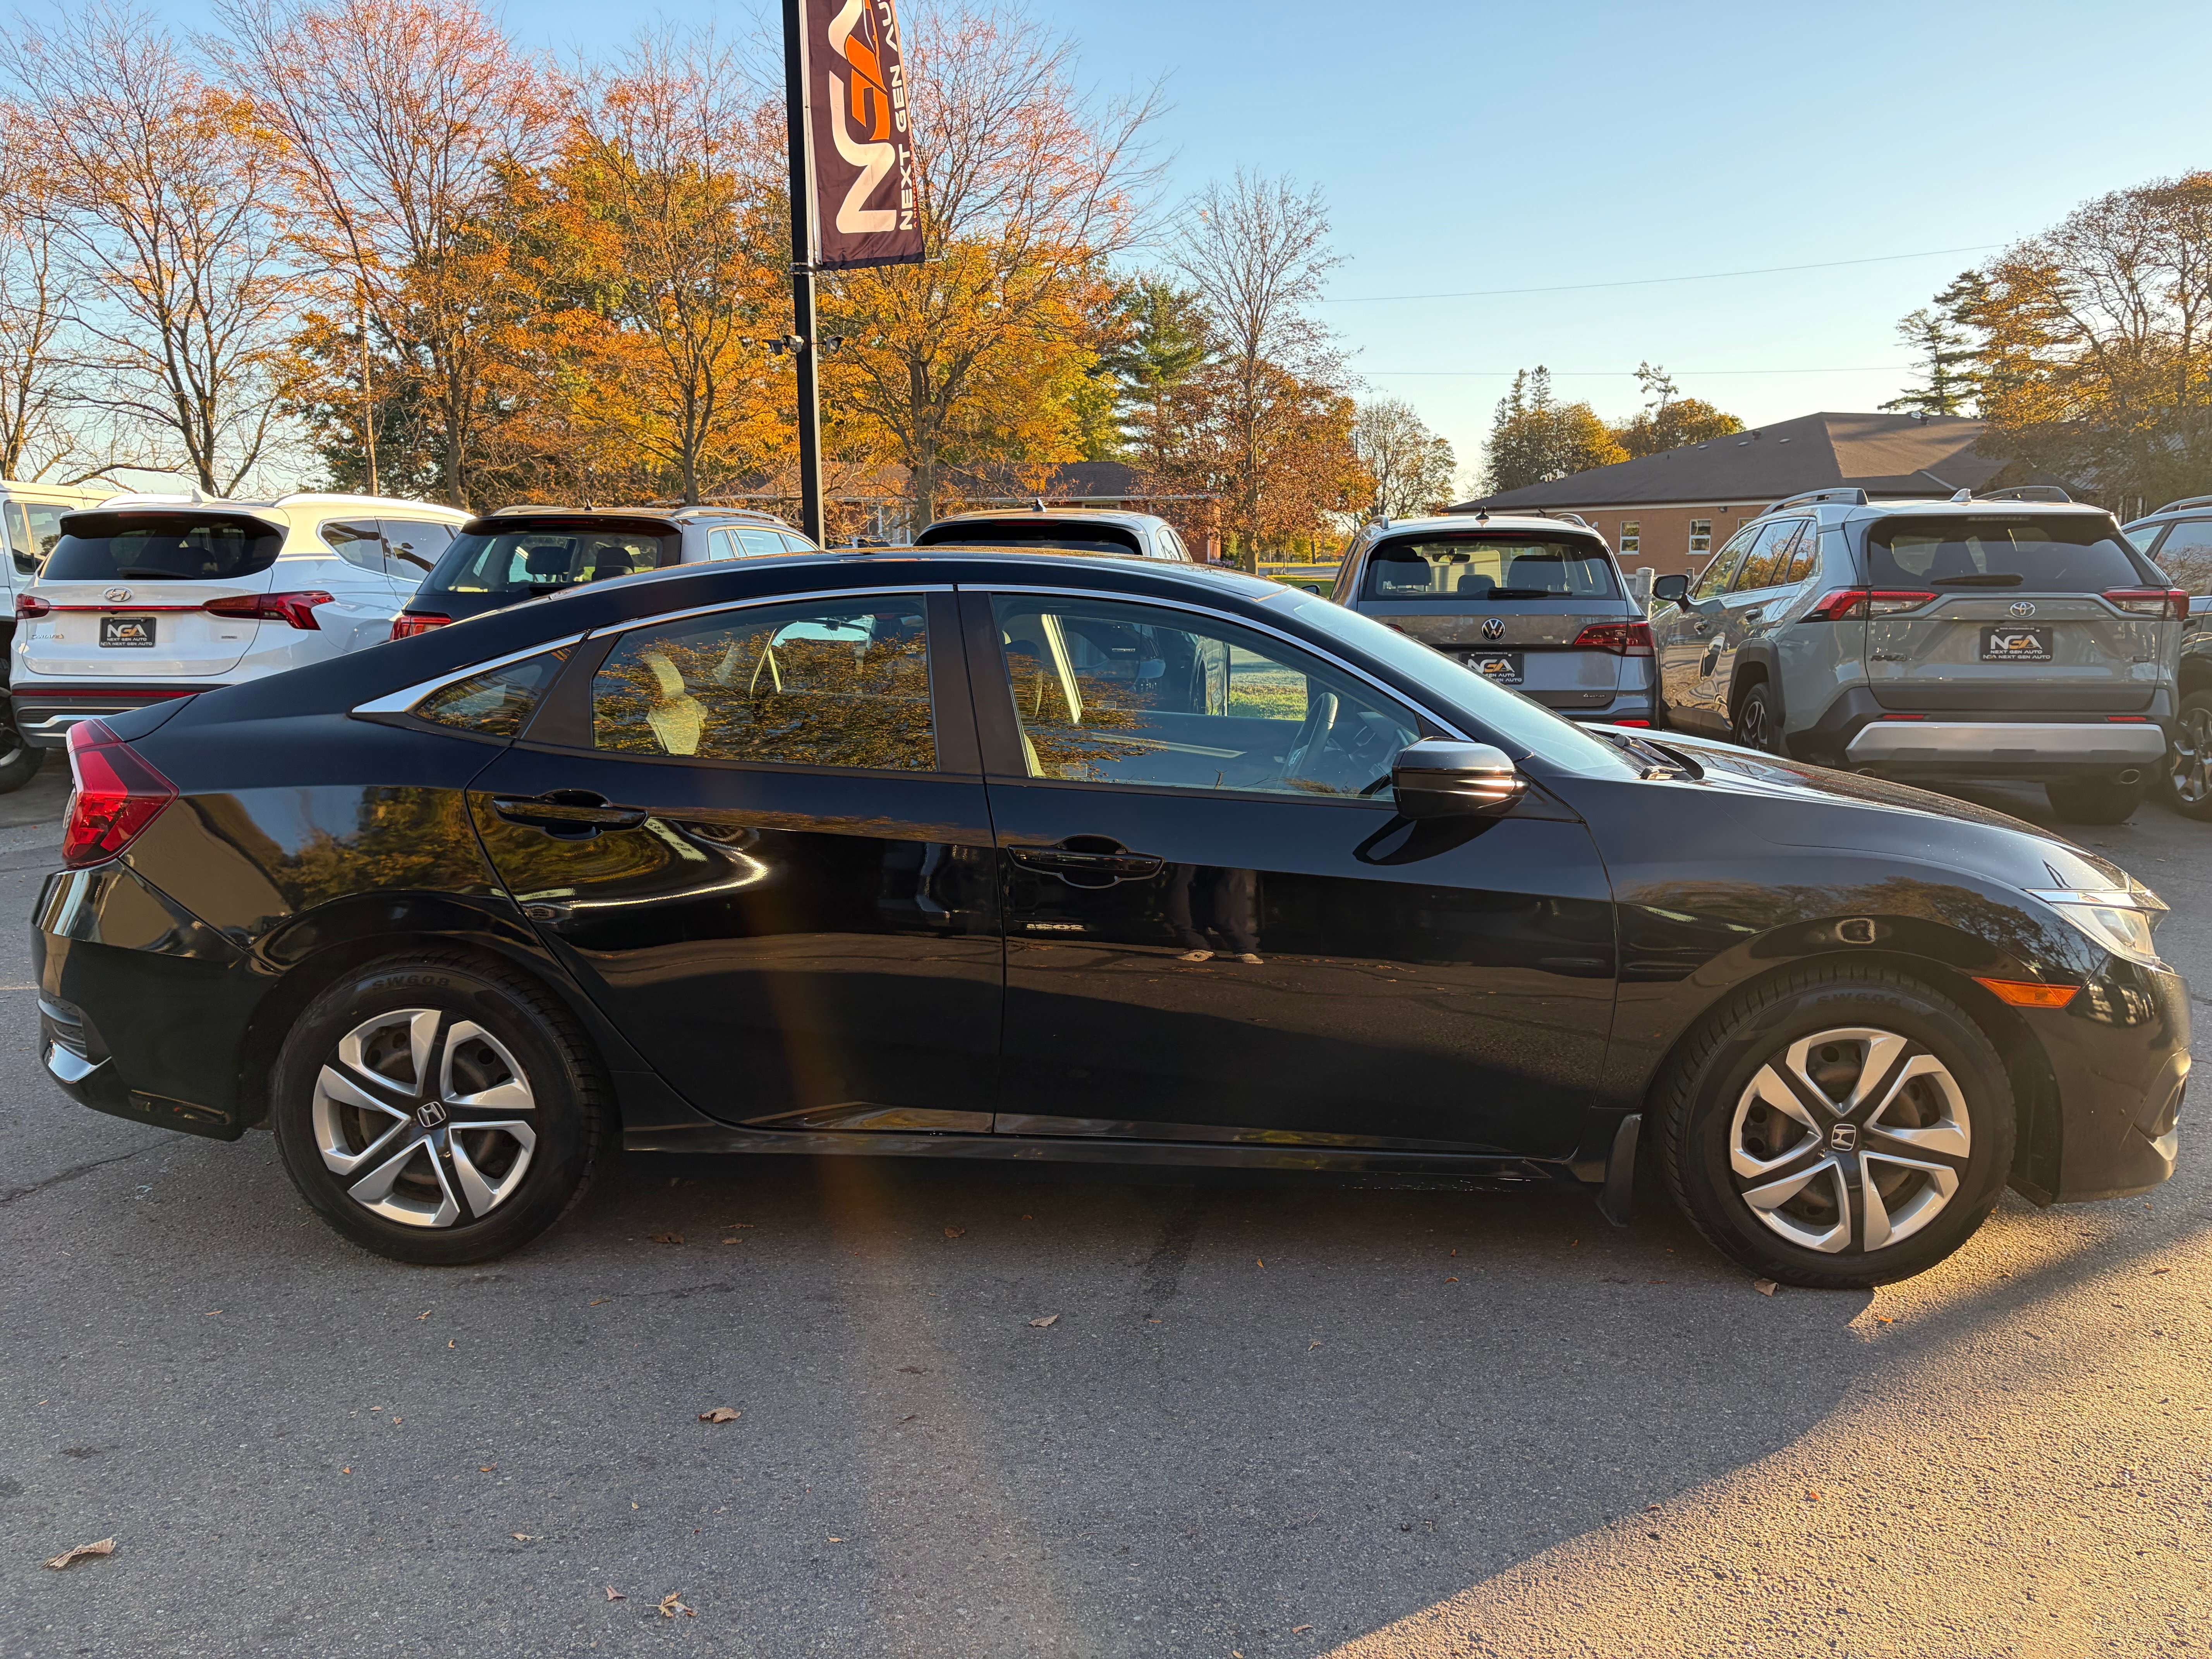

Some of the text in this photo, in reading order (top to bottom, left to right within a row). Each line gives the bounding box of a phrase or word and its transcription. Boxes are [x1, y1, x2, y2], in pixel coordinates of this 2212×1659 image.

[878, 0, 913, 230] NEXT GEN AU
[107, 624, 147, 637] NGA
[1990, 635, 2042, 649] NGA
[372, 975, 450, 990] SW608
